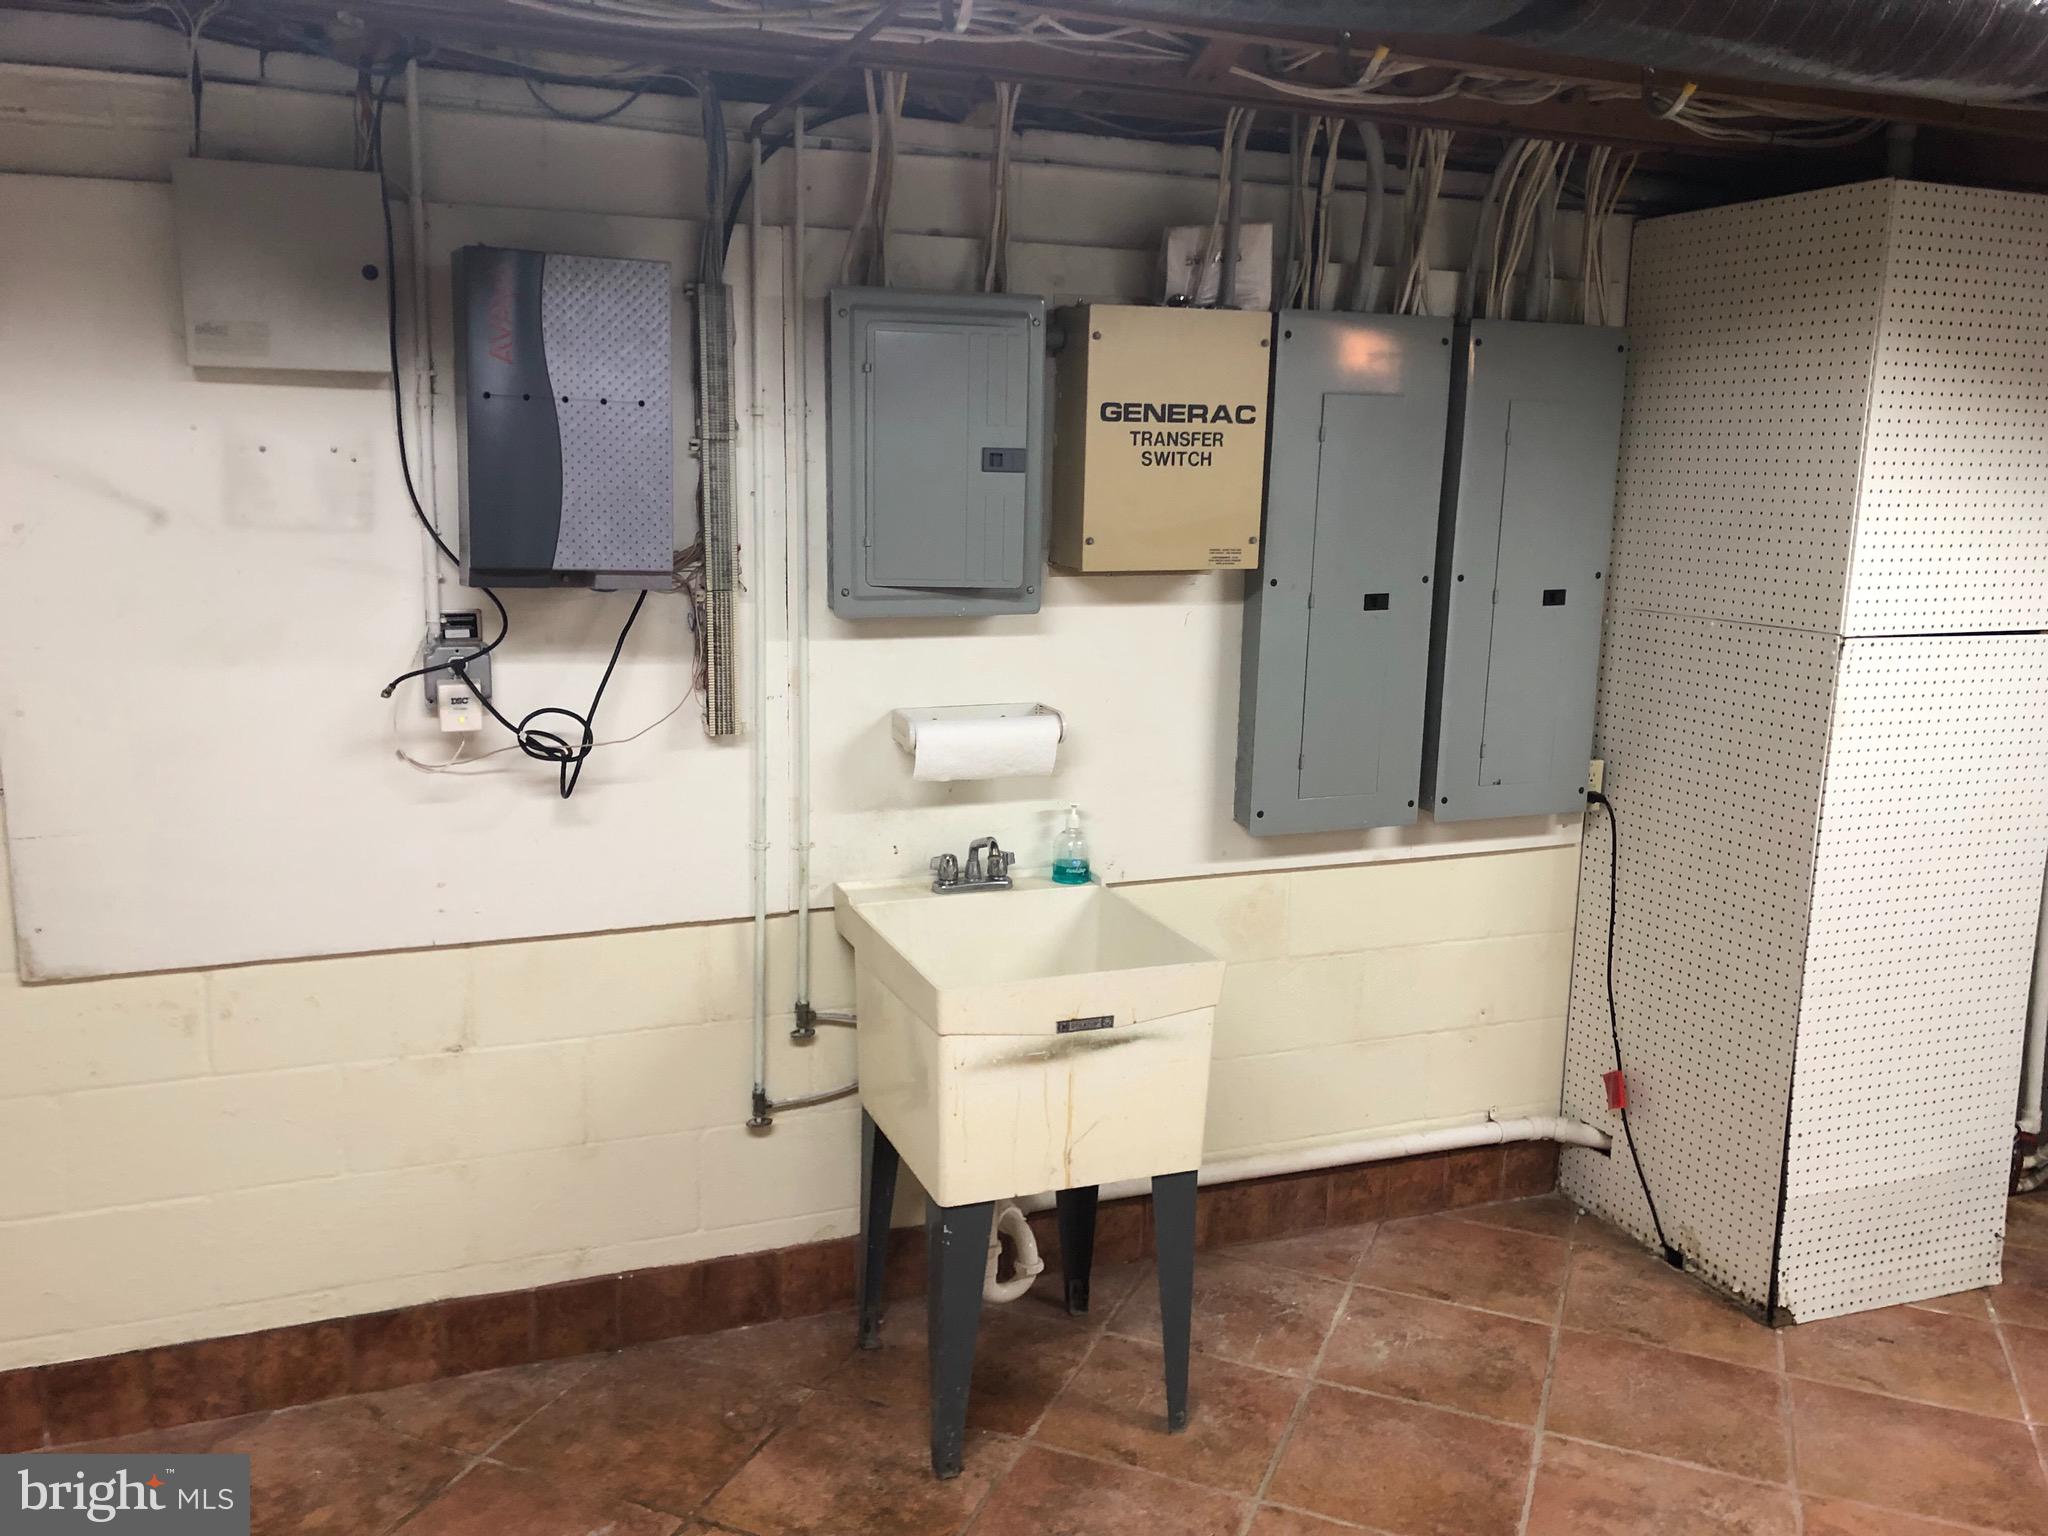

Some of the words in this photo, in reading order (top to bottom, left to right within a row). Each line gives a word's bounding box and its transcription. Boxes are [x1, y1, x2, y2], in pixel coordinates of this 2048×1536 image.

[487, 267, 513, 364] AVA
[1100, 402, 1256, 424] GENERAC
[1130, 431, 1224, 447] TRANSFER
[1141, 451, 1212, 466] SWITCH
[451, 697, 469, 705] DSC
